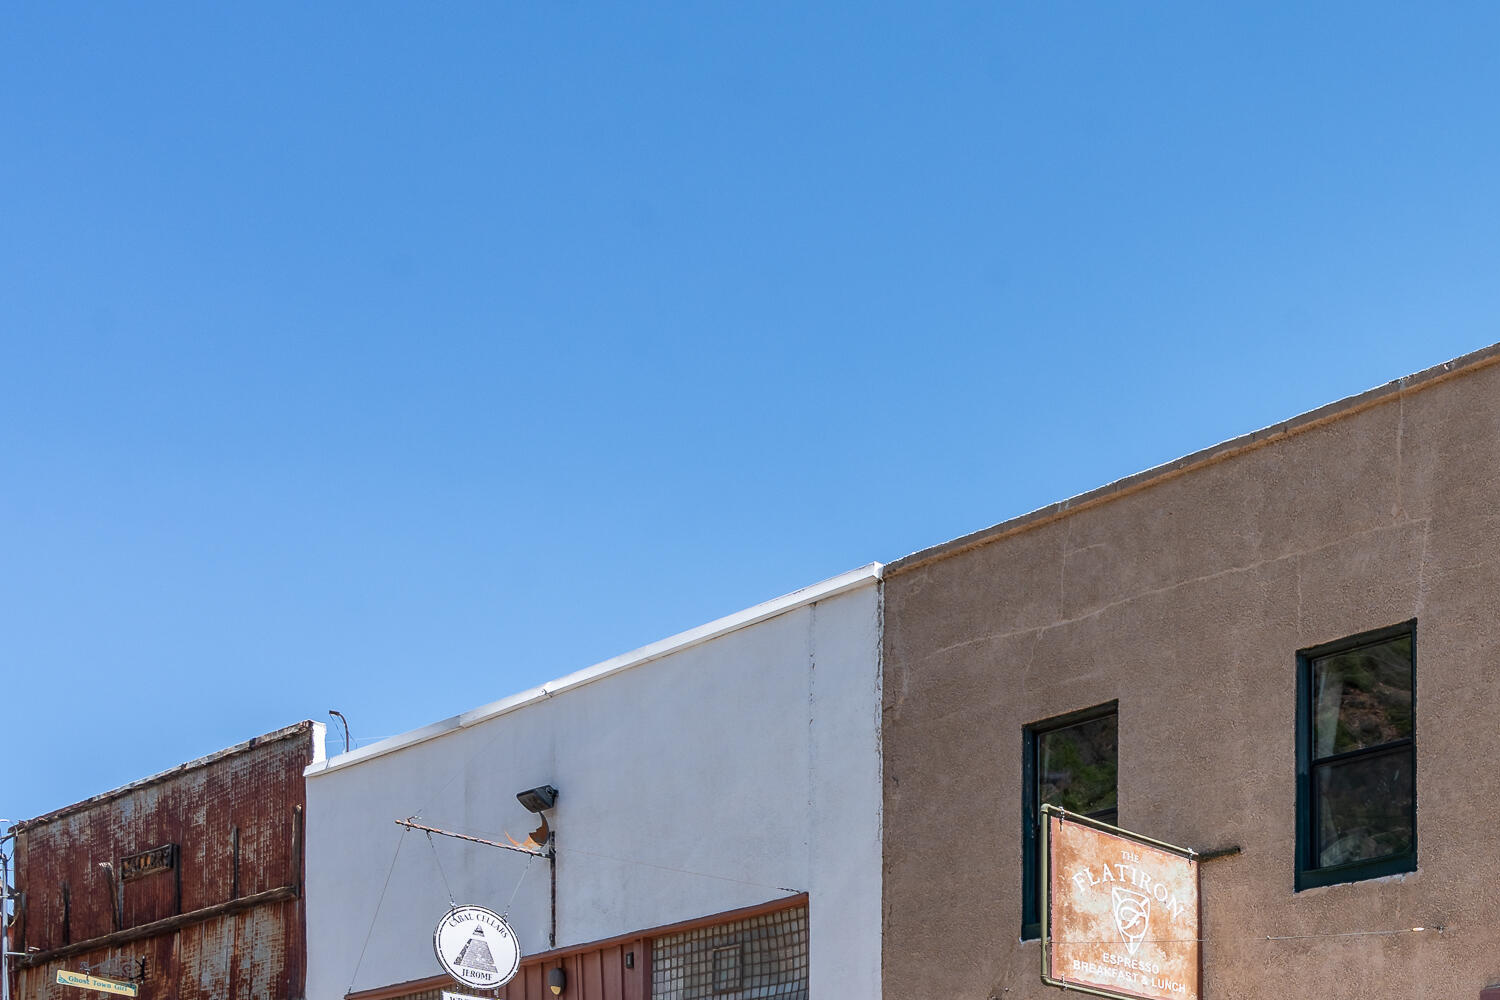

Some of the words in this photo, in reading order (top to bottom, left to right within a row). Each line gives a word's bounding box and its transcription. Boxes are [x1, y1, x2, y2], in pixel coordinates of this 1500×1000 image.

[1120, 850, 1140, 863] THE
[1072, 863, 1185, 920] FLATIRON
[449, 913, 474, 928] CABAL
[476, 913, 508, 938] CELLARS
[462, 968, 493, 981] JEROME
[1102, 952, 1160, 975] ESPRESSO
[68, 975, 90, 985] Ghost
[93, 979, 111, 989] Town
[1073, 960, 1138, 983] BREAKFAST
[1141, 976, 1148, 986] &
[1151, 978, 1186, 993] LUNCH
